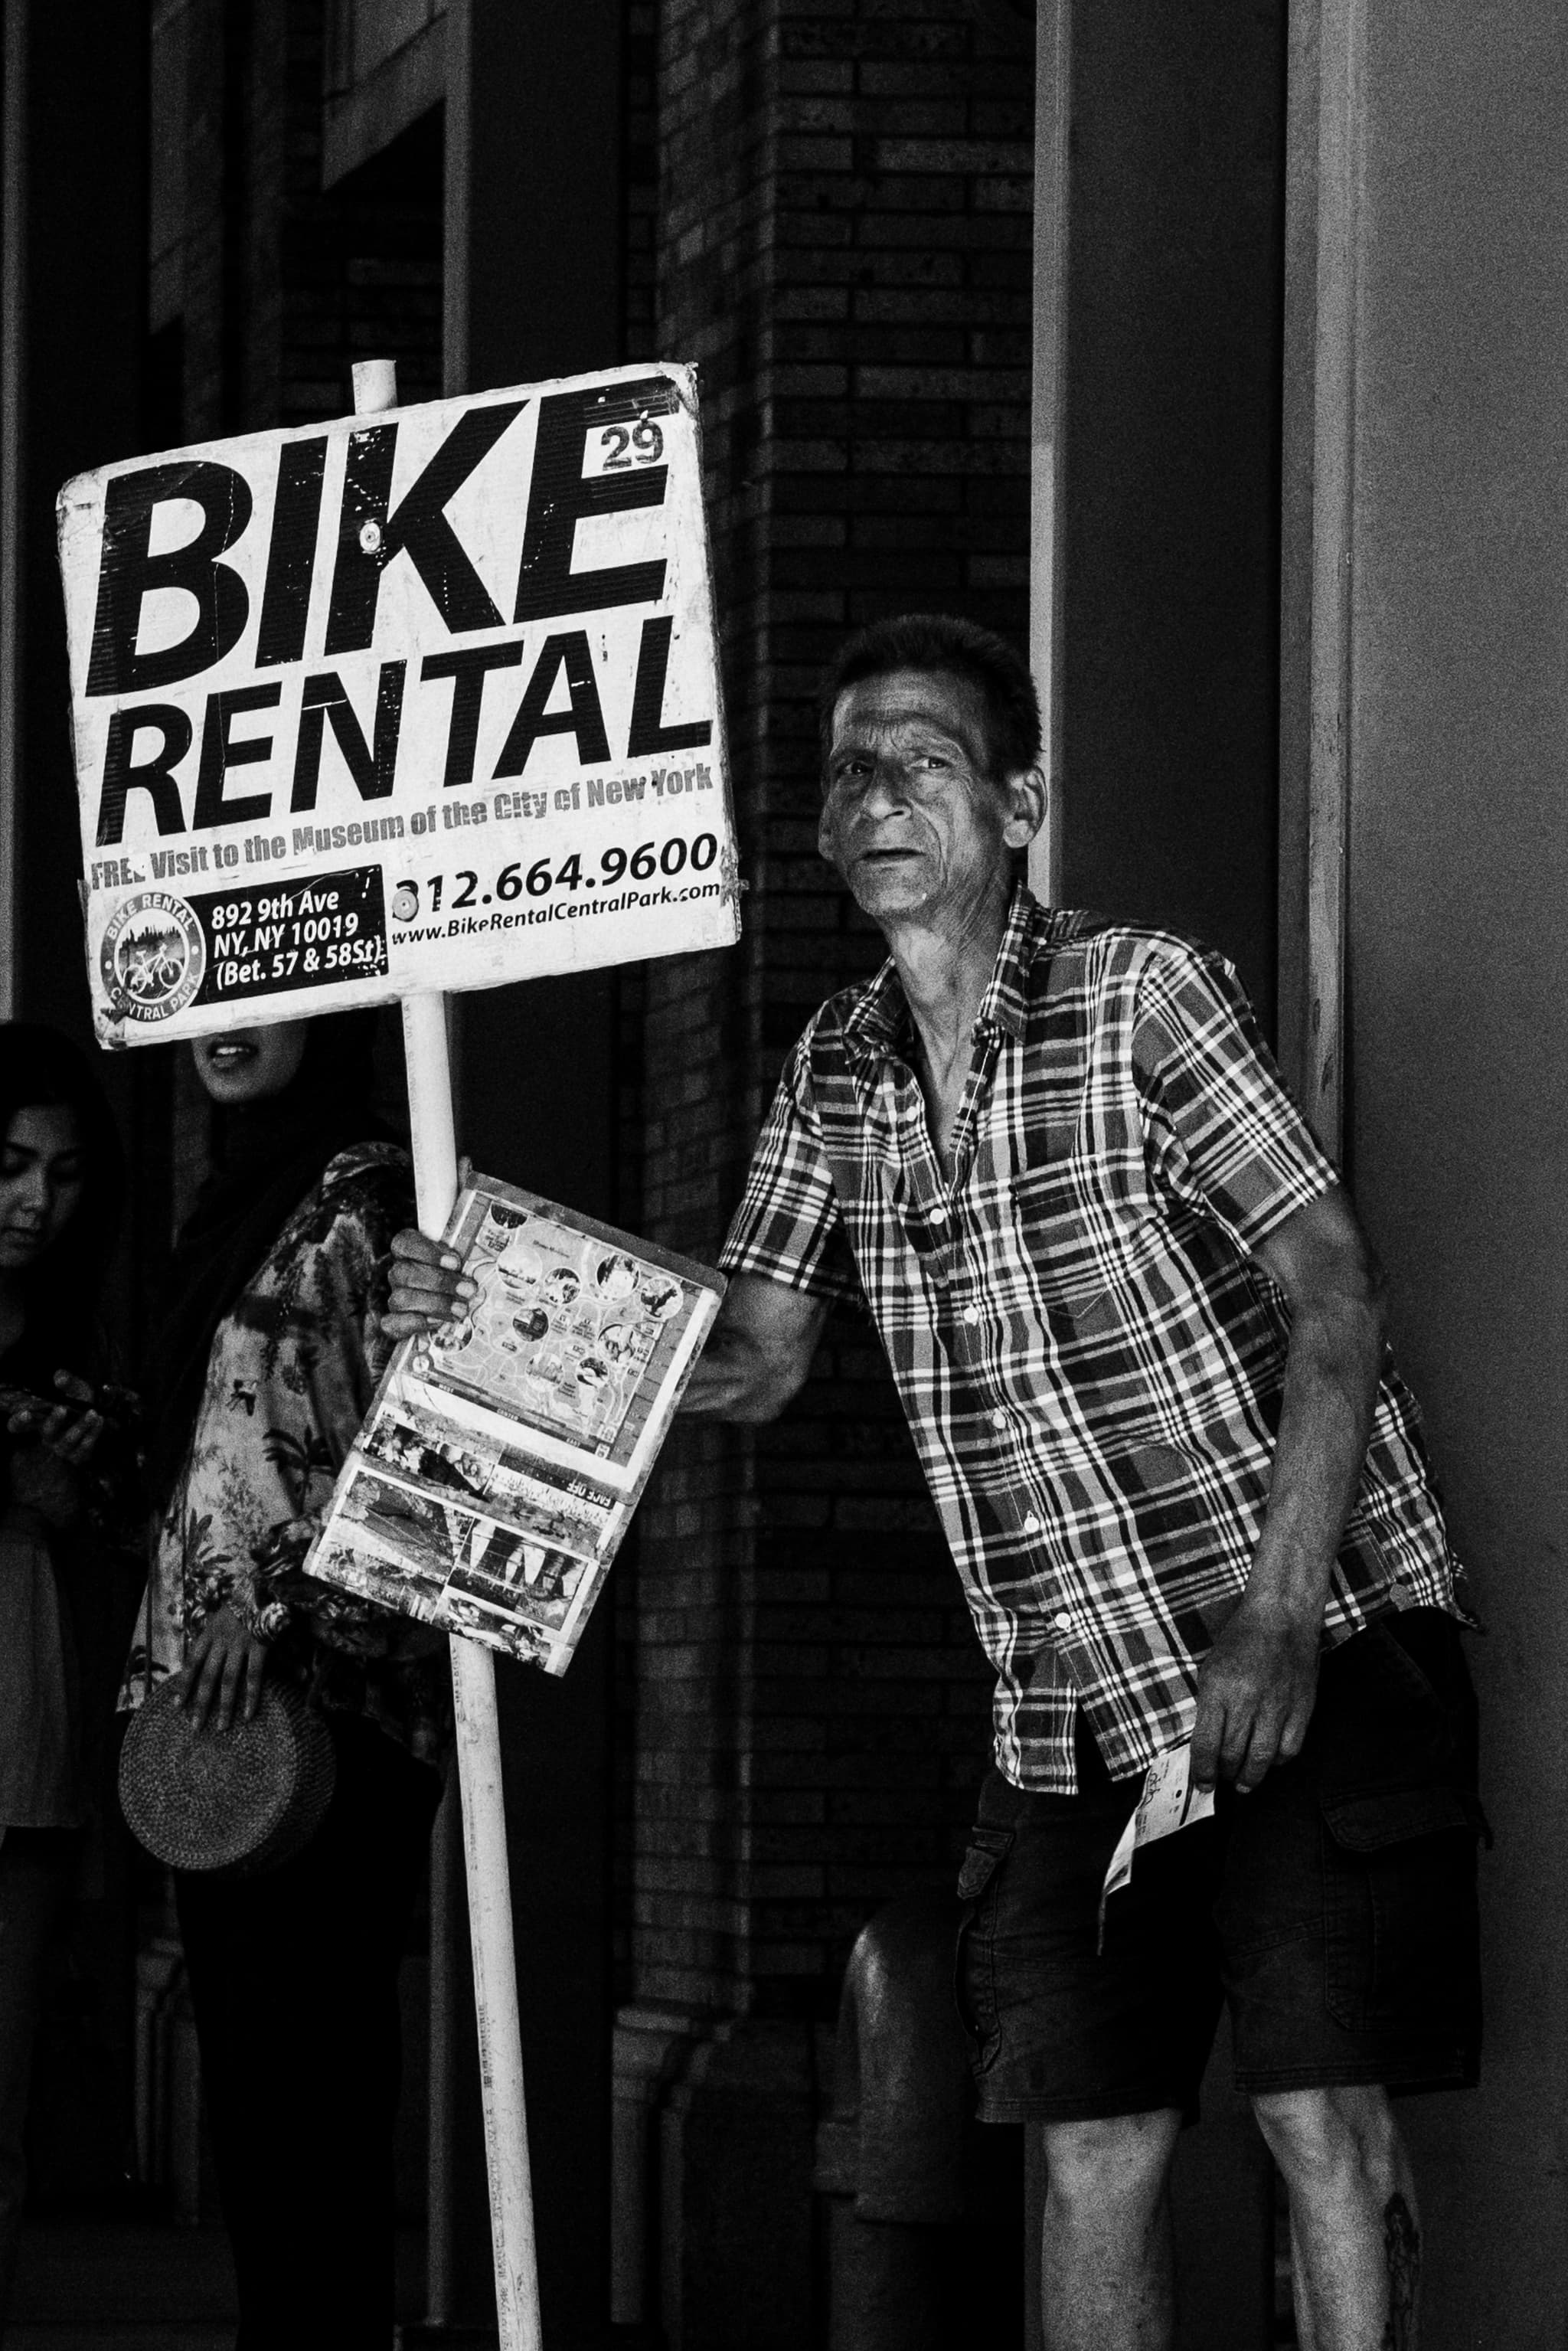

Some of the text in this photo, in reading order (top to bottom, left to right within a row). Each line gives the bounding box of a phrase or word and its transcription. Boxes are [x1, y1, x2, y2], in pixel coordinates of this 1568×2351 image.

[599, 423, 665, 472] 29
[84, 374, 681, 698] BIKE
[95, 615, 713, 848] RENTAL
[149, 846, 210, 880] Visit
[213, 842, 239, 869] to
[243, 833, 287, 864] the
[292, 814, 404, 856] Museum
[410, 805, 437, 835] of
[442, 798, 488, 830] the
[493, 790, 547, 821] City
[554, 783, 581, 811] of
[587, 776, 647, 809] New
[651, 763, 714, 796] York
[106, 893, 194, 940] BIKE RENTAL
[211, 890, 339, 930] 892 9th Ave
[391, 882, 720, 945] www.BikeRentalCentralPark.com
[213, 912, 359, 959] NY, NY 10019
[217, 960, 267, 992] (Bet.
[273, 951, 299, 977] 57
[304, 948, 320, 973] &
[109, 973, 198, 1022] CNTRAL PARK
